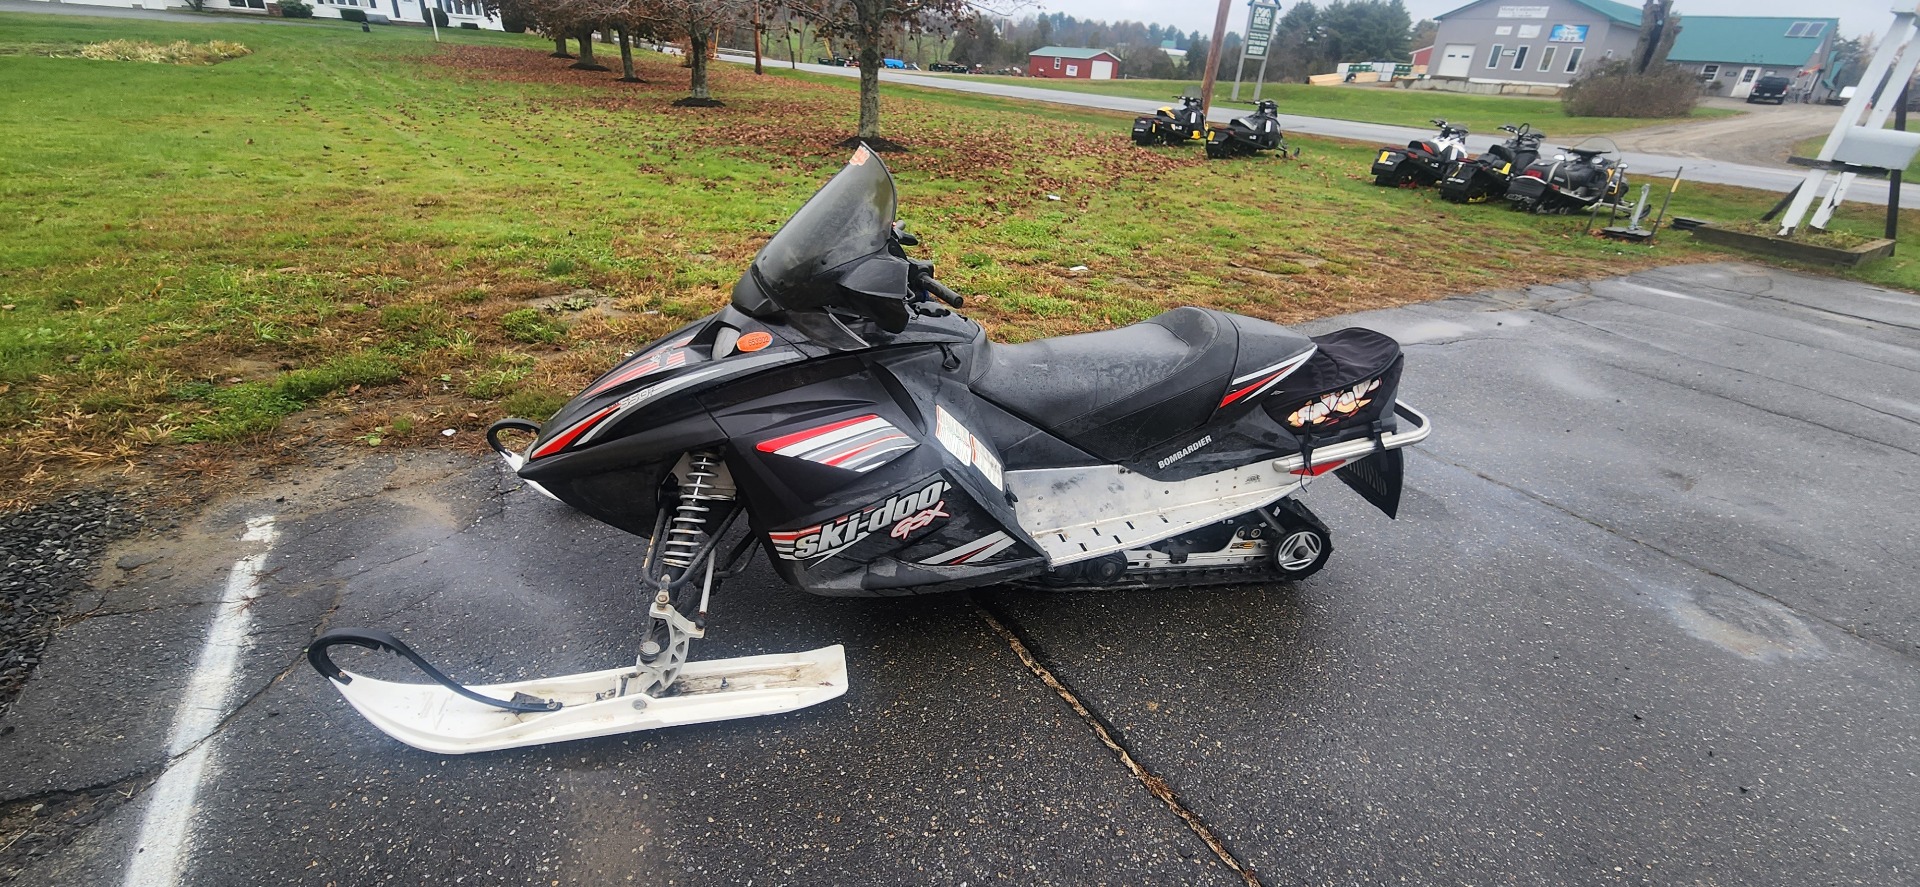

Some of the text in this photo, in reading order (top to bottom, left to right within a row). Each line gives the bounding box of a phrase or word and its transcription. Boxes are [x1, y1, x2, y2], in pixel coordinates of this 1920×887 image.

[1157, 434, 1212, 469] BOMBARDIER
[794, 481, 943, 558] ski-doo
[890, 500, 950, 539] GSX
